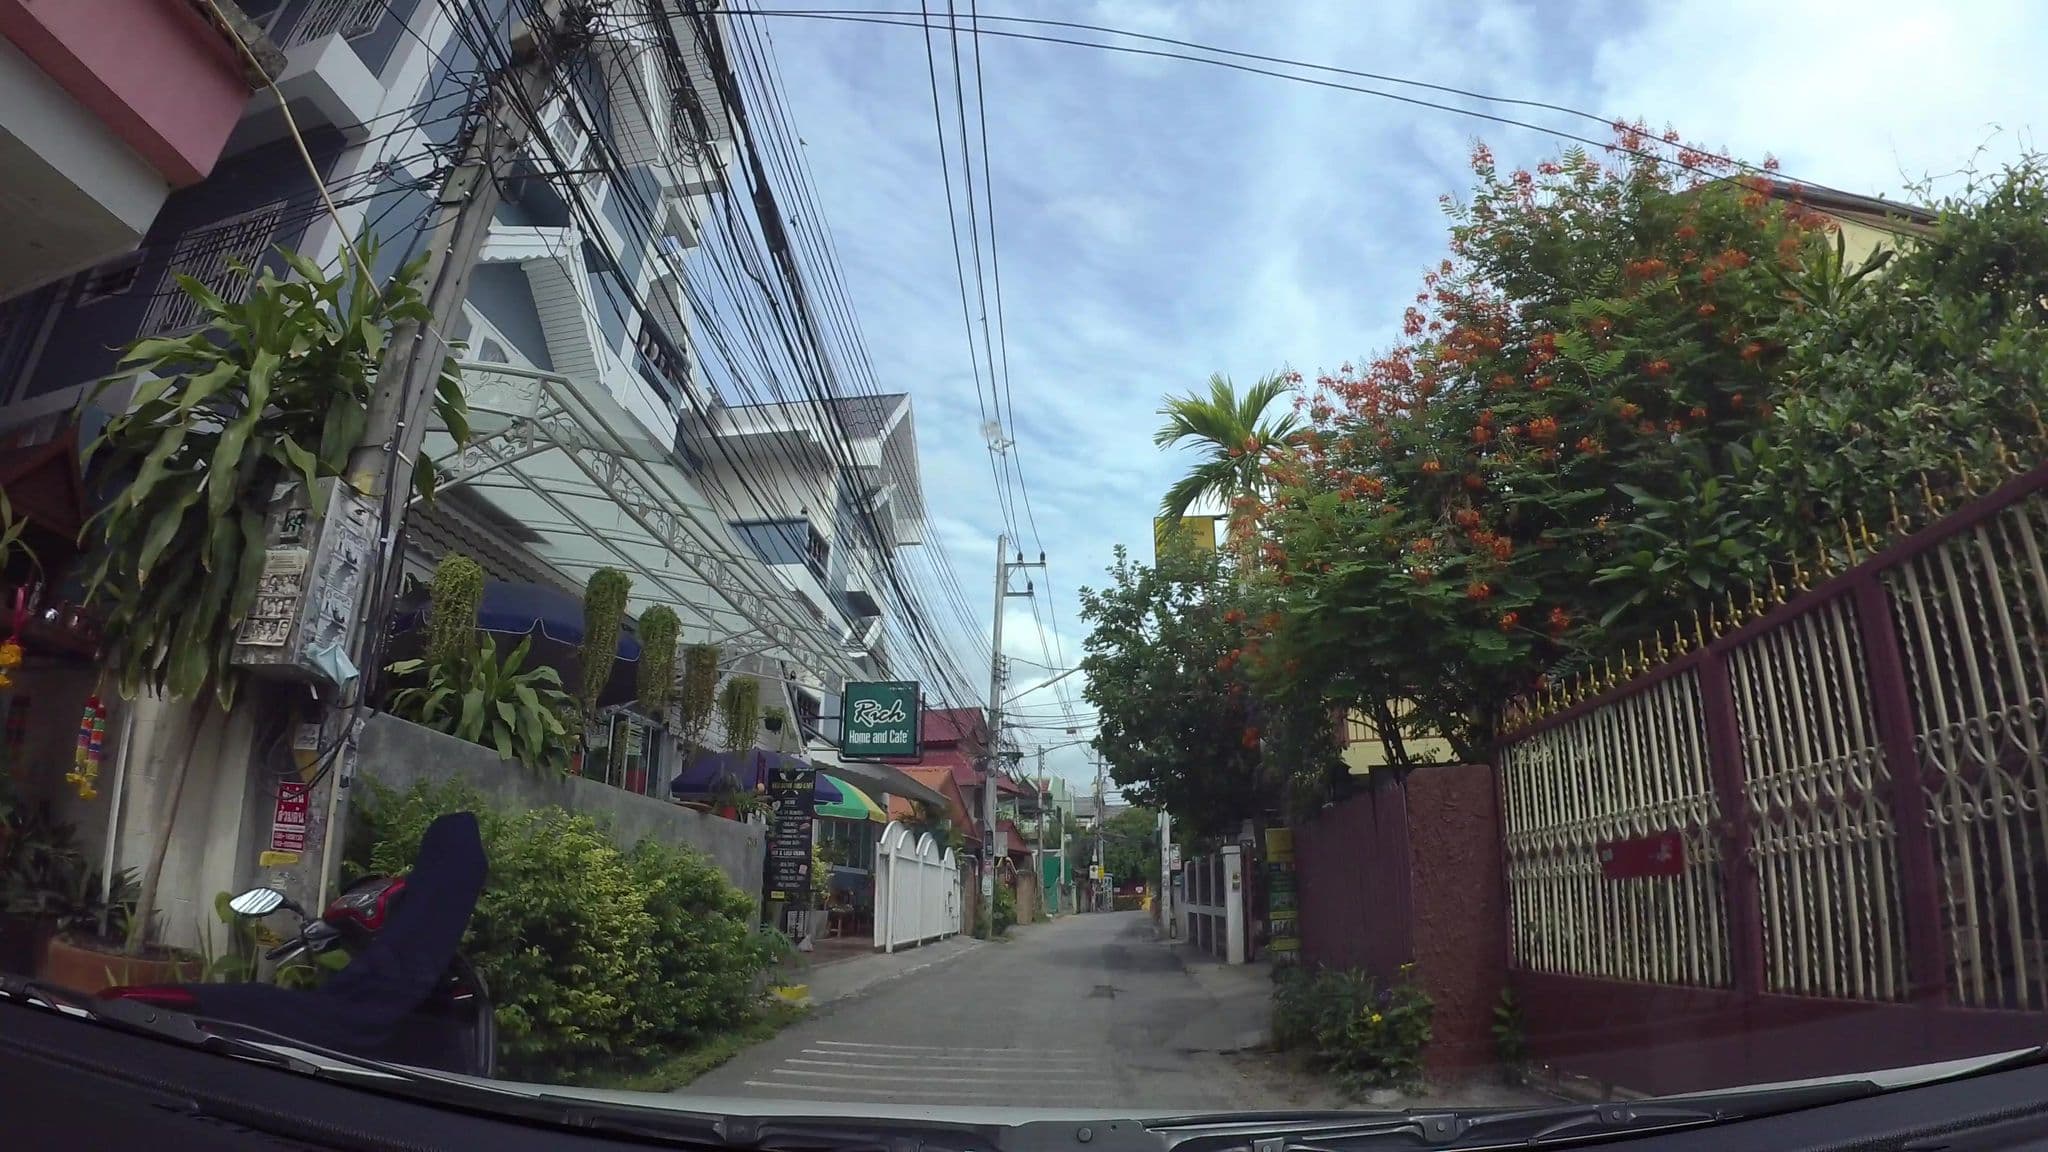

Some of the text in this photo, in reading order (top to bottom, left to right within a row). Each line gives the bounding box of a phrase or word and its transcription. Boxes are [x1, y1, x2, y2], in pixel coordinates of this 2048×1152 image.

[854, 699, 906, 727] Rich
[849, 729, 871, 743] Home
[873, 729, 888, 743] and
